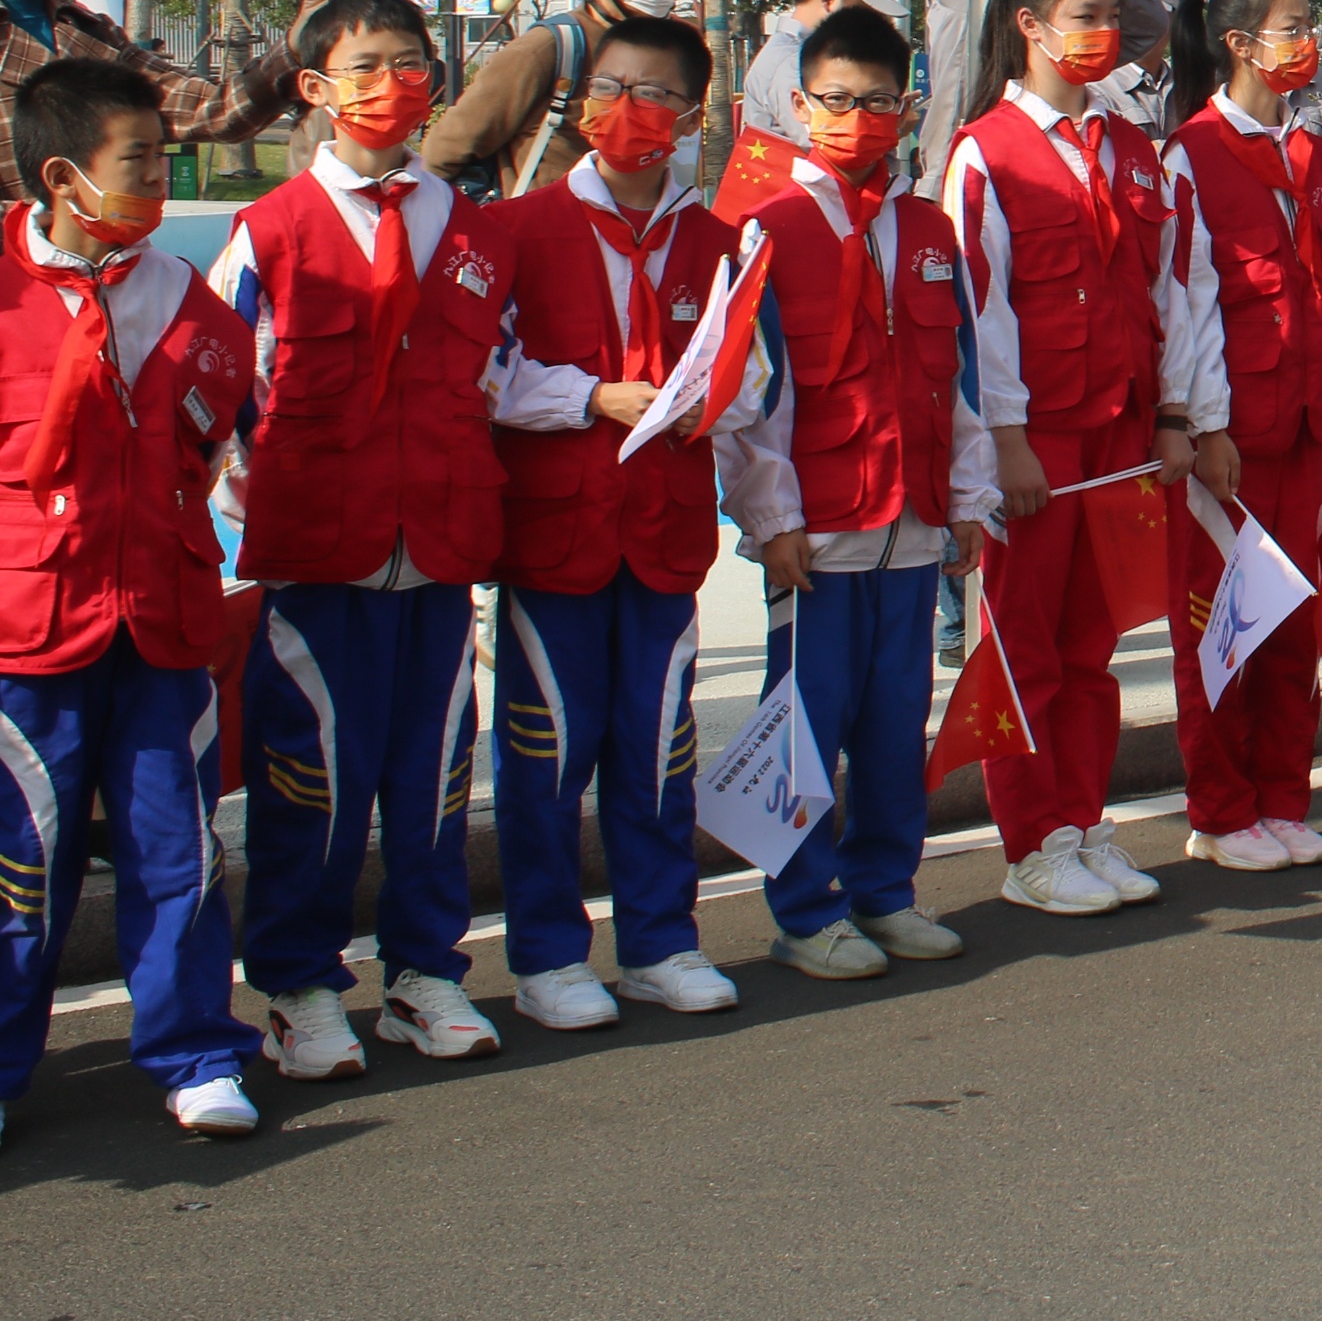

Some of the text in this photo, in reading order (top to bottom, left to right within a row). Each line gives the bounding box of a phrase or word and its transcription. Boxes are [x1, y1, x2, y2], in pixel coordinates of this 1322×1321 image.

[770, 699, 782, 710] The
[745, 721, 763, 740] Games
[714, 702, 791, 794] 江西省第十六届运动会
[707, 763, 727, 785] Province
[741, 756, 774, 795] 2022 九江
